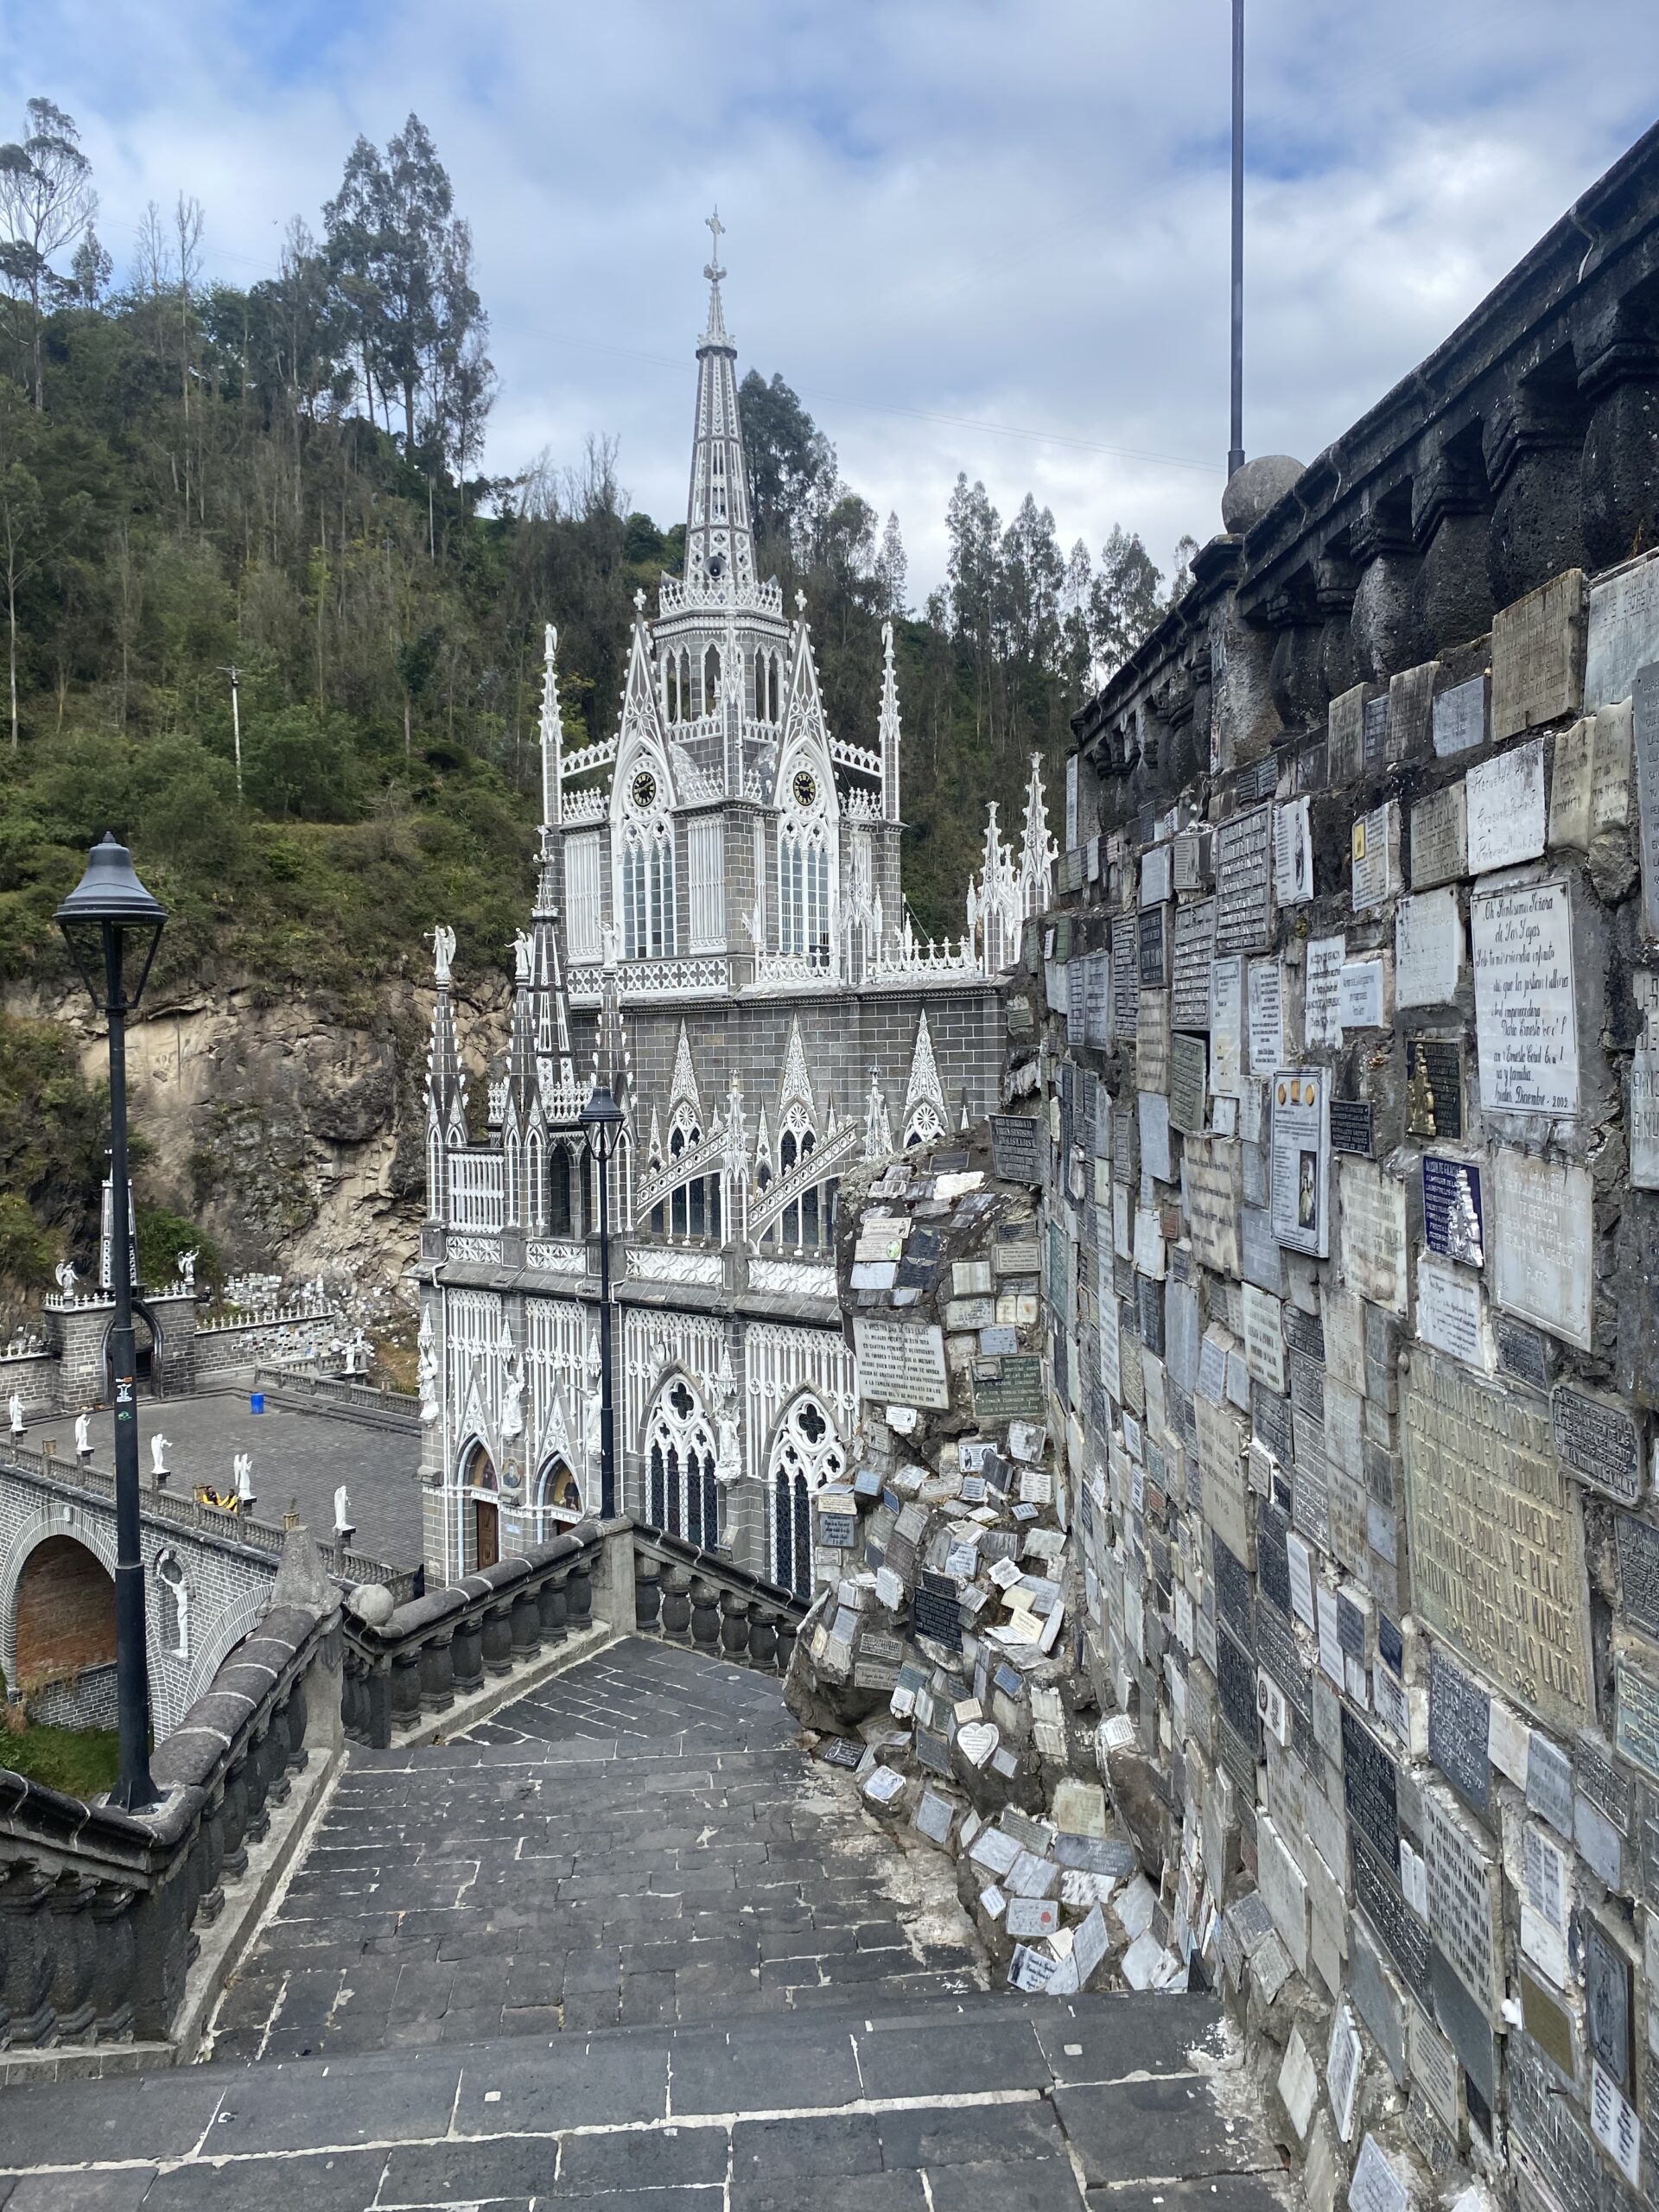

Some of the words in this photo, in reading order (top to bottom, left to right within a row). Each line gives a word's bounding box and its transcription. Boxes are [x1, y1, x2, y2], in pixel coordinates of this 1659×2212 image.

[1552, 1096, 1568, 1108] 2002
[1510, 1537, 1527, 1580] DE
[1514, 1583, 1529, 1623] SU
[1532, 1594, 1572, 1654] MADRE
